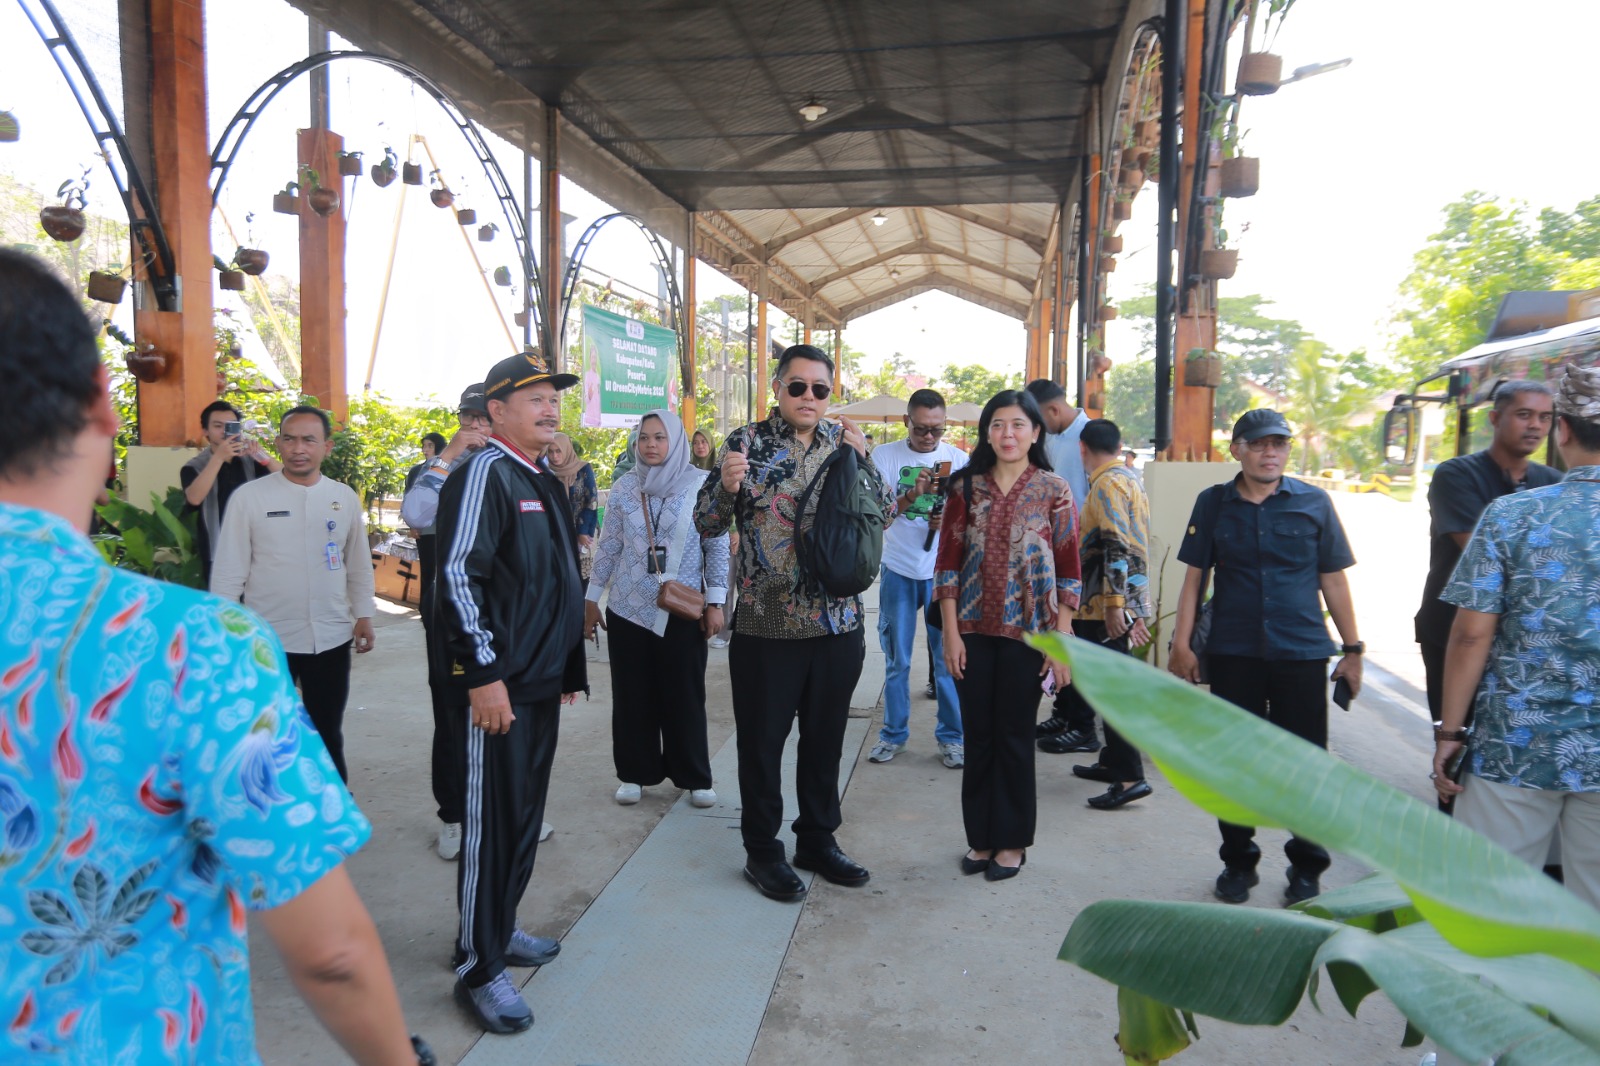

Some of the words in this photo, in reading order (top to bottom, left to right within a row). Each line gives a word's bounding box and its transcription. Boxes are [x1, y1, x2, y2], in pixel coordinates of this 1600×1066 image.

[612, 338, 637, 353] SELAMAT
[638, 343, 657, 357] DATANG
[616, 353, 655, 369] Kabupaten/Kota
[627, 369, 646, 381] Peserta
[605, 380, 612, 391] UI
